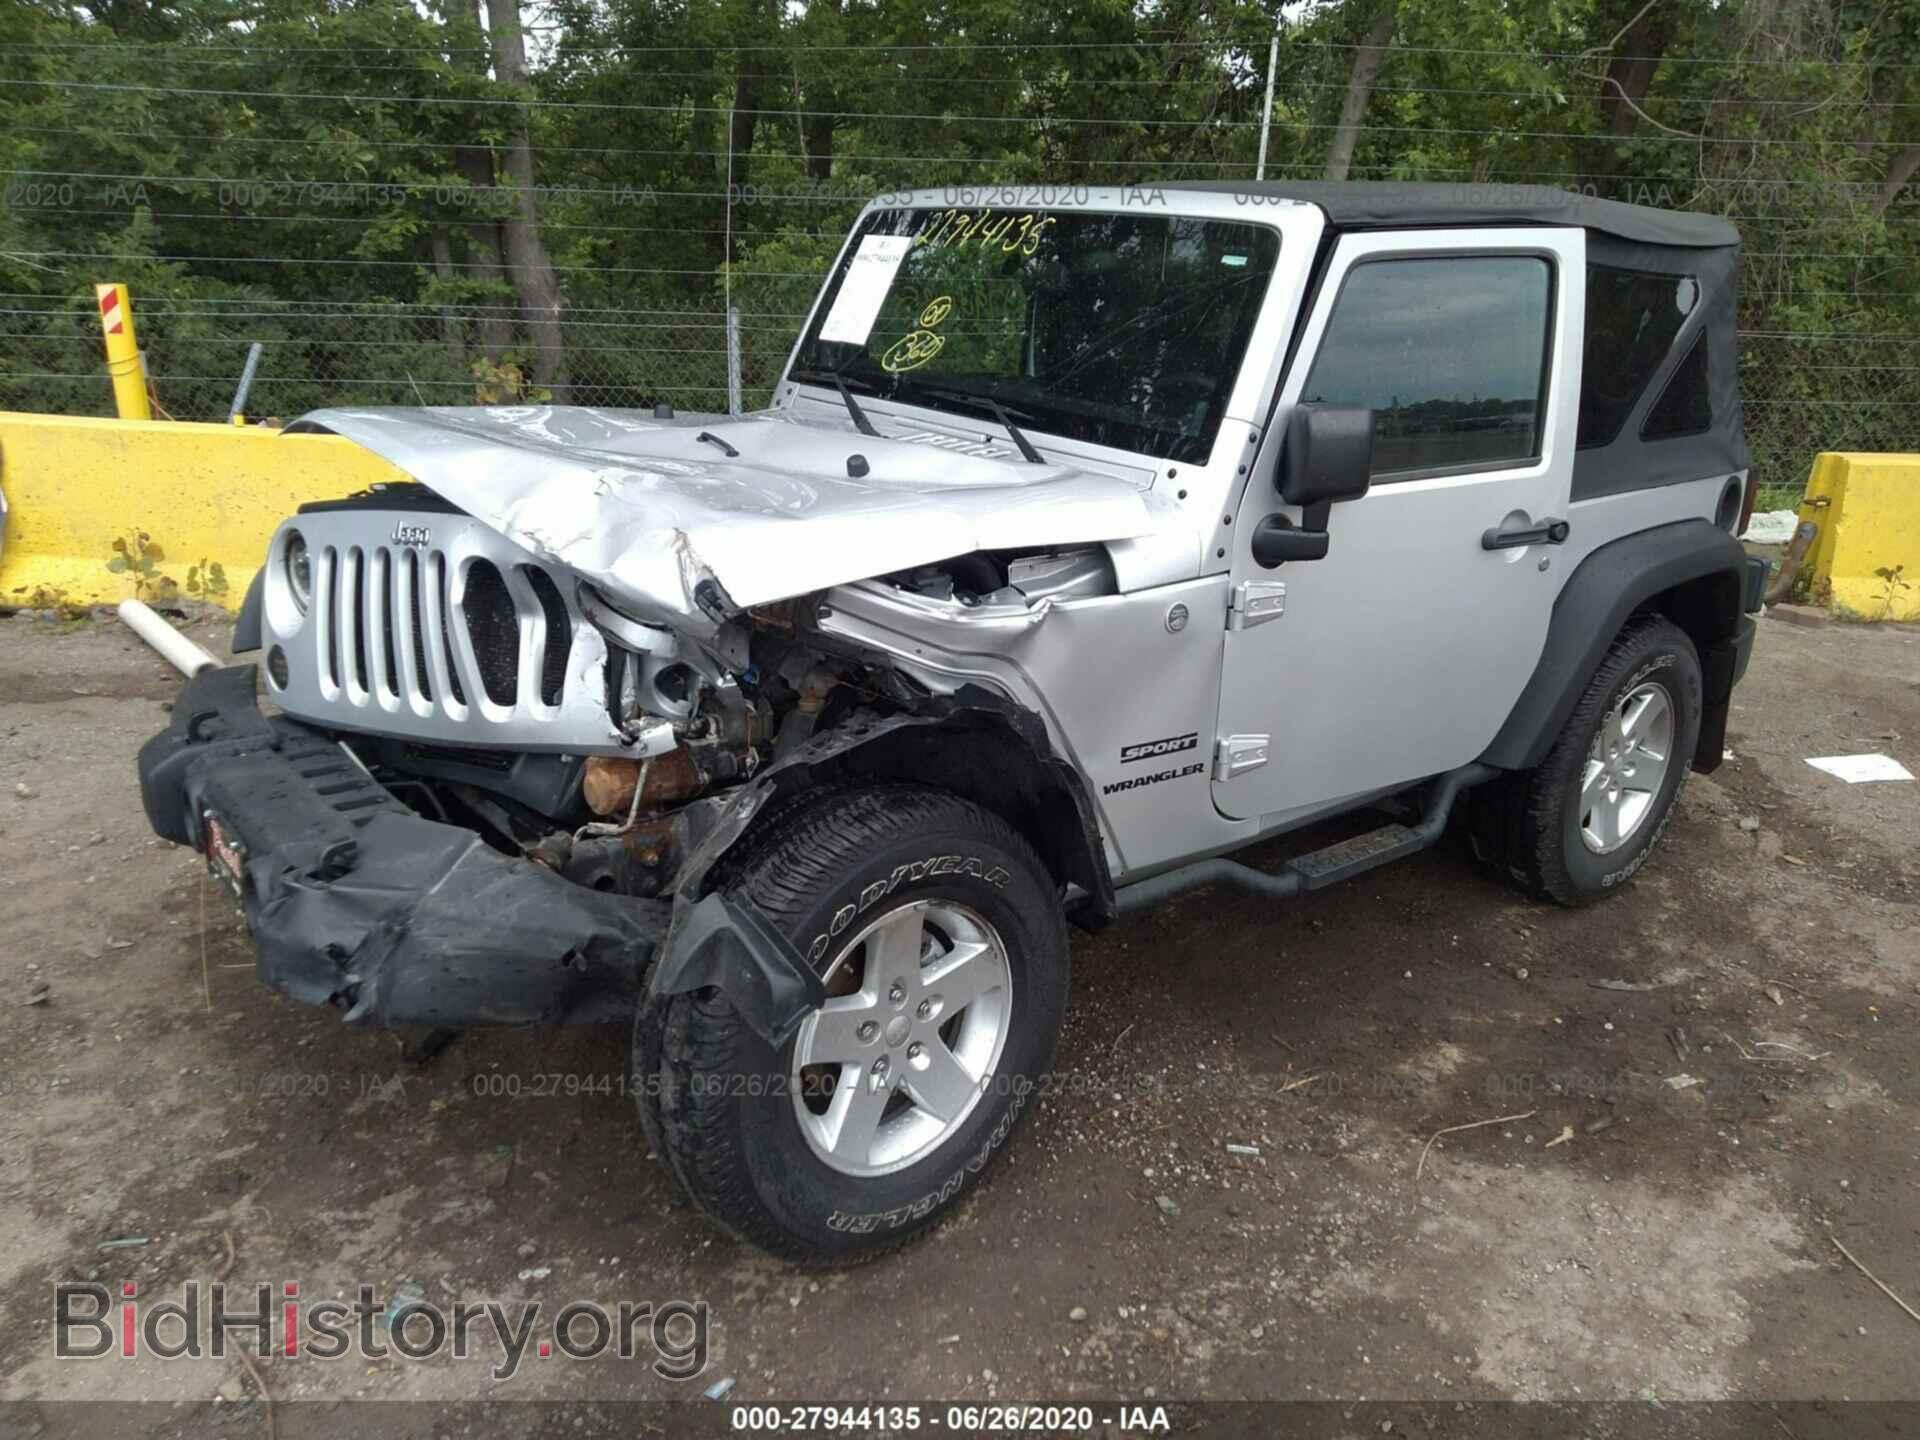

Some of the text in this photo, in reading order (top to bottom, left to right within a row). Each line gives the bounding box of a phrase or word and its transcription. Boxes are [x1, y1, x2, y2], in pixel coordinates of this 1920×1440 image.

[391, 520, 431, 552] Jeep
[1123, 737, 1194, 760] SPORT
[1103, 762, 1204, 795] WRANGLER
[806, 855, 1011, 967] OODYEAR
